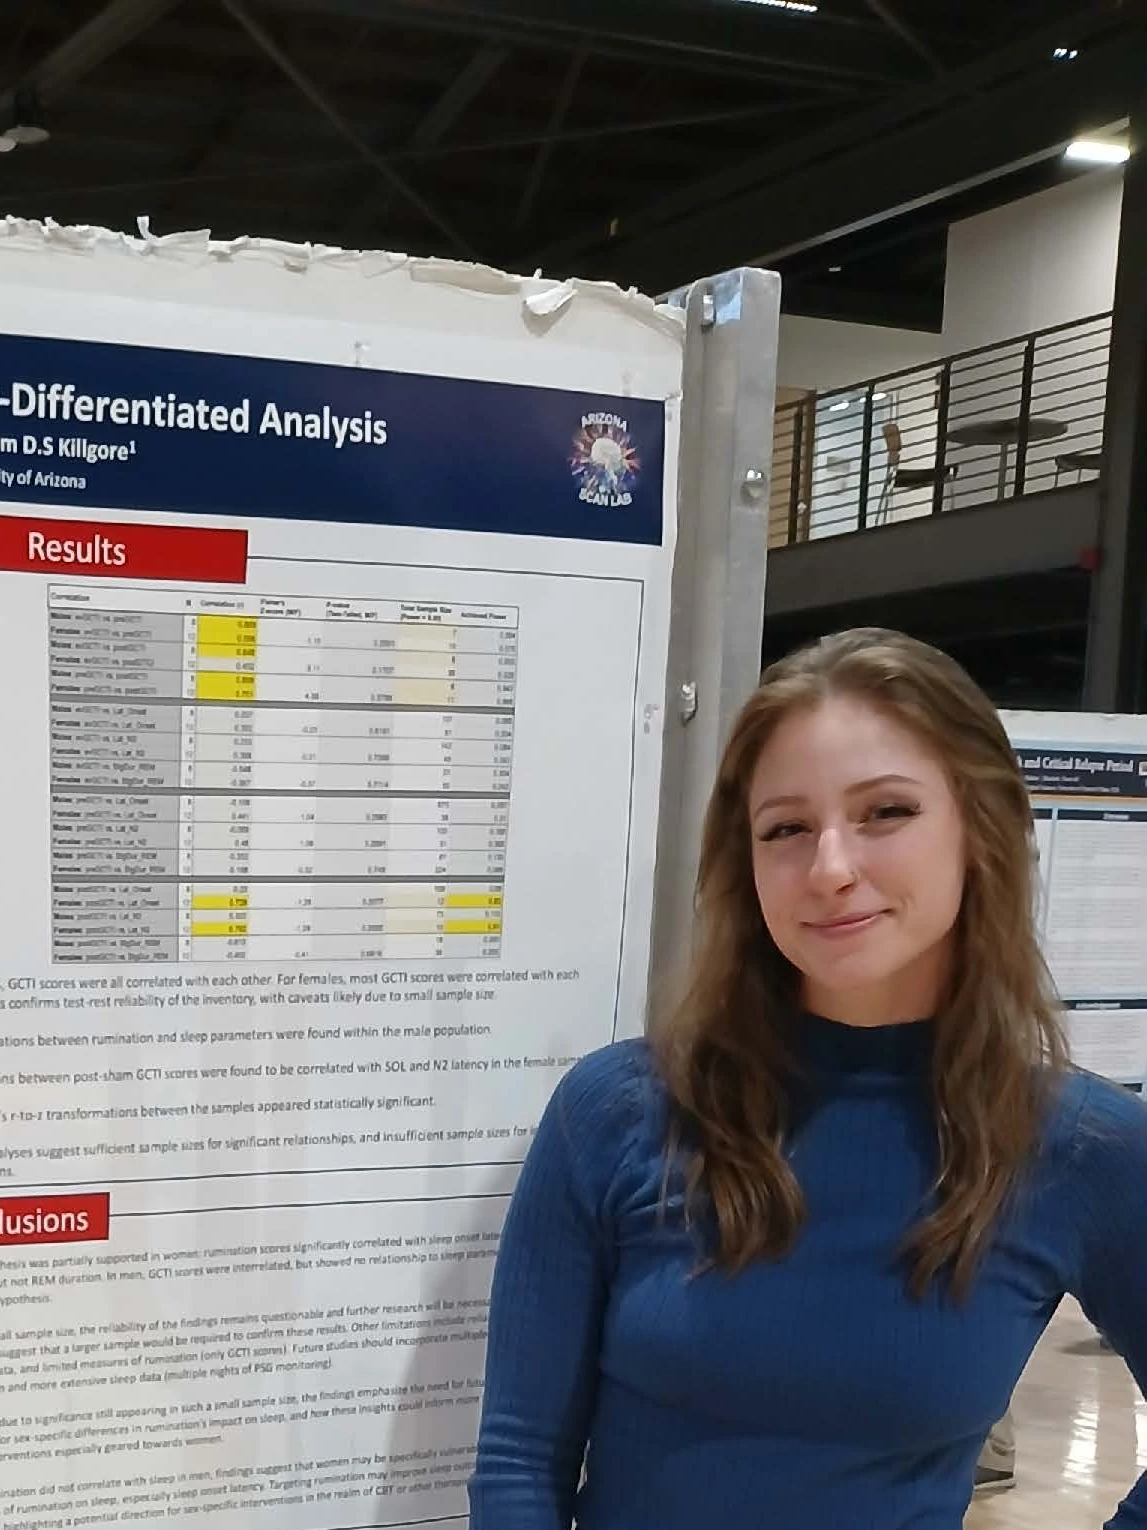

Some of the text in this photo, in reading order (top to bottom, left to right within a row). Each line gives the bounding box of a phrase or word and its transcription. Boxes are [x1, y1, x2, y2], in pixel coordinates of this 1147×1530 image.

[260, 403, 386, 448] Analysis
[581, 412, 627, 432] ARIZONA
[23, 436, 53, 455] D.S
[17, 470, 32, 485] of
[35, 472, 86, 489] Arizona
[579, 487, 633, 507] SCAN LAB
[29, 532, 125, 565] Results
